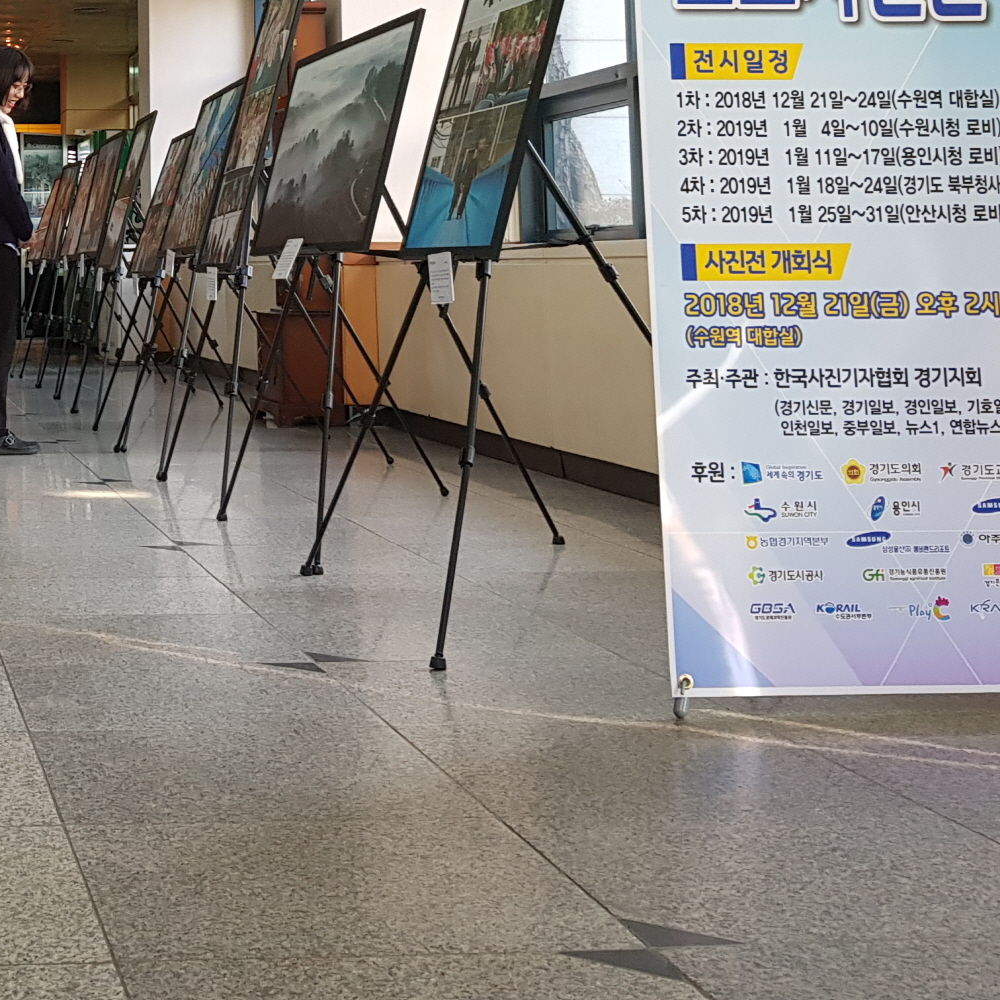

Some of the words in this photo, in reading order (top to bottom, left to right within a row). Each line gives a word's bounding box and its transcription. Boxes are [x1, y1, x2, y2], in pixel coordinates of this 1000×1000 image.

[693, 49, 789, 74] 전시일정
[676, 90, 701, 109] 1차
[714, 90, 766, 109] 2018년
[772, 89, 805, 110] 12월
[948, 88, 1000, 109] 대합실)
[677, 119, 702, 138] 2차
[716, 119, 768, 138] 2019년
[783, 118, 807, 138] 1월
[678, 147, 704, 167] 3차
[717, 147, 769, 167] 2019년
[785, 146, 809, 167] 1월
[680, 176, 705, 195] 4차
[719, 176, 771, 195] 2019년
[787, 175, 811, 195] 1월
[682, 204, 707, 224] 5차
[721, 204, 773, 224] 2019년
[788, 204, 812, 224] 1월
[704, 249, 766, 275] 사진전
[771, 249, 832, 275] 개회식
[683, 291, 766, 319] 2018년
[770, 291, 819, 319] 12월
[823, 290, 910, 319] 21일(금)
[915, 291, 959, 319] 오후
[963, 291, 1000, 318] 2시
[685, 324, 743, 348] (수원역
[745, 324, 803, 348] 대합실)
[686, 368, 759, 389] 주최·주관
[773, 367, 909, 389] 한국사진기자협회
[914, 366, 982, 388] 경기지회
[774, 398, 837, 417] (경기신문,
[842, 399, 899, 416] 경기일보,
[904, 398, 962, 416] 경인일보,
[780, 420, 839, 437] 인천일보,
[842, 419, 901, 436] 중부일보,
[905, 419, 945, 436] 뉴스1,
[691, 461, 725, 484] 후원
[869, 462, 922, 475] 경기도의회
[892, 500, 921, 516] 용인시
[768, 570, 824, 582] 경기도시공사
[750, 603, 796, 614] GBSA
[816, 602, 861, 614] KORAIL
